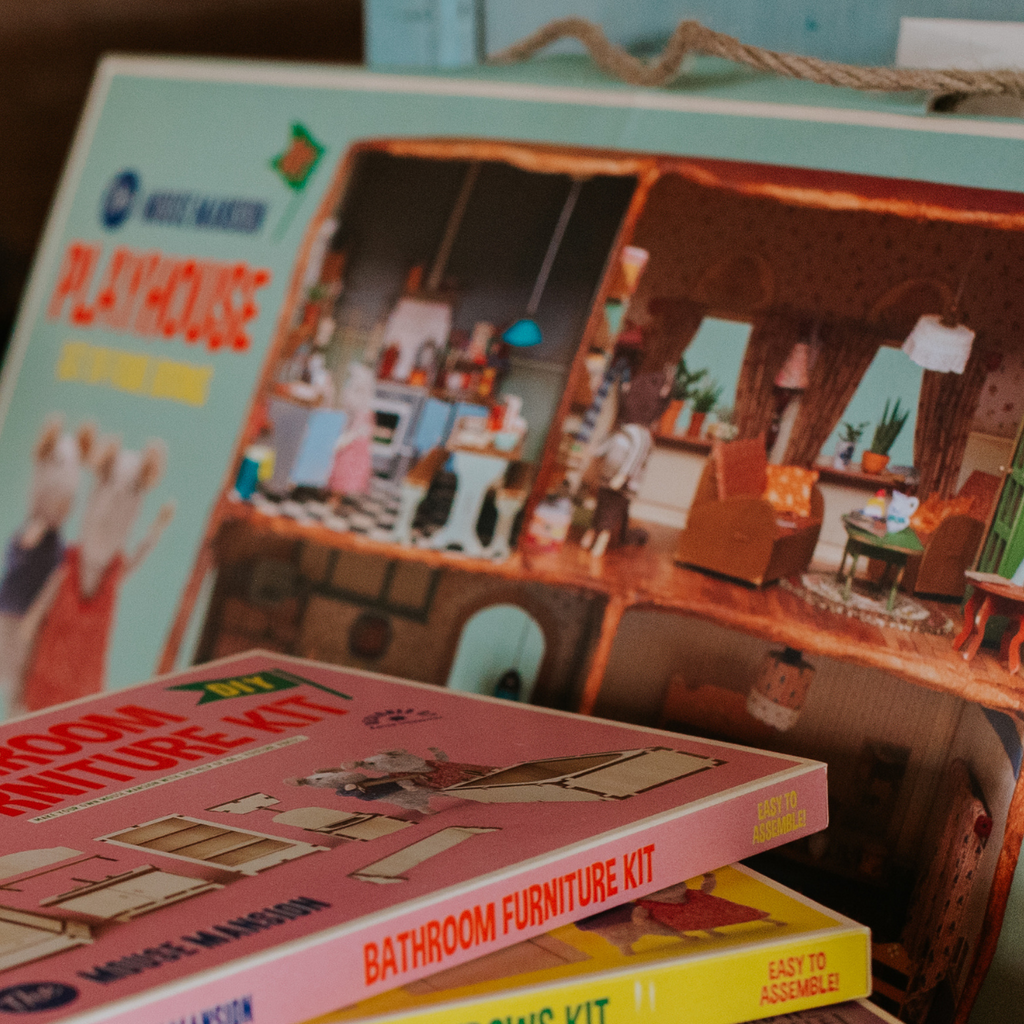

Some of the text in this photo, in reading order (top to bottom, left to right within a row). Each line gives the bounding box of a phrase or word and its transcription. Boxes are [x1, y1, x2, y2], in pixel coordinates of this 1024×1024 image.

[48, 241, 271, 351] PLAYHOUSE
[205, 676, 275, 698] DIY
[221, 695, 349, 735] KIT
[757, 790, 798, 820] EASY TO
[752, 809, 807, 845] ASSEMBLE!
[363, 901, 496, 986] BATHROOM
[501, 859, 619, 938] FURNITURE
[623, 843, 656, 890] KIT
[77, 939, 188, 983] MOUSE
[182, 895, 332, 950] MANSION
[768, 952, 827, 981] EASY TO
[760, 972, 840, 1006] ASSEMBLE!
